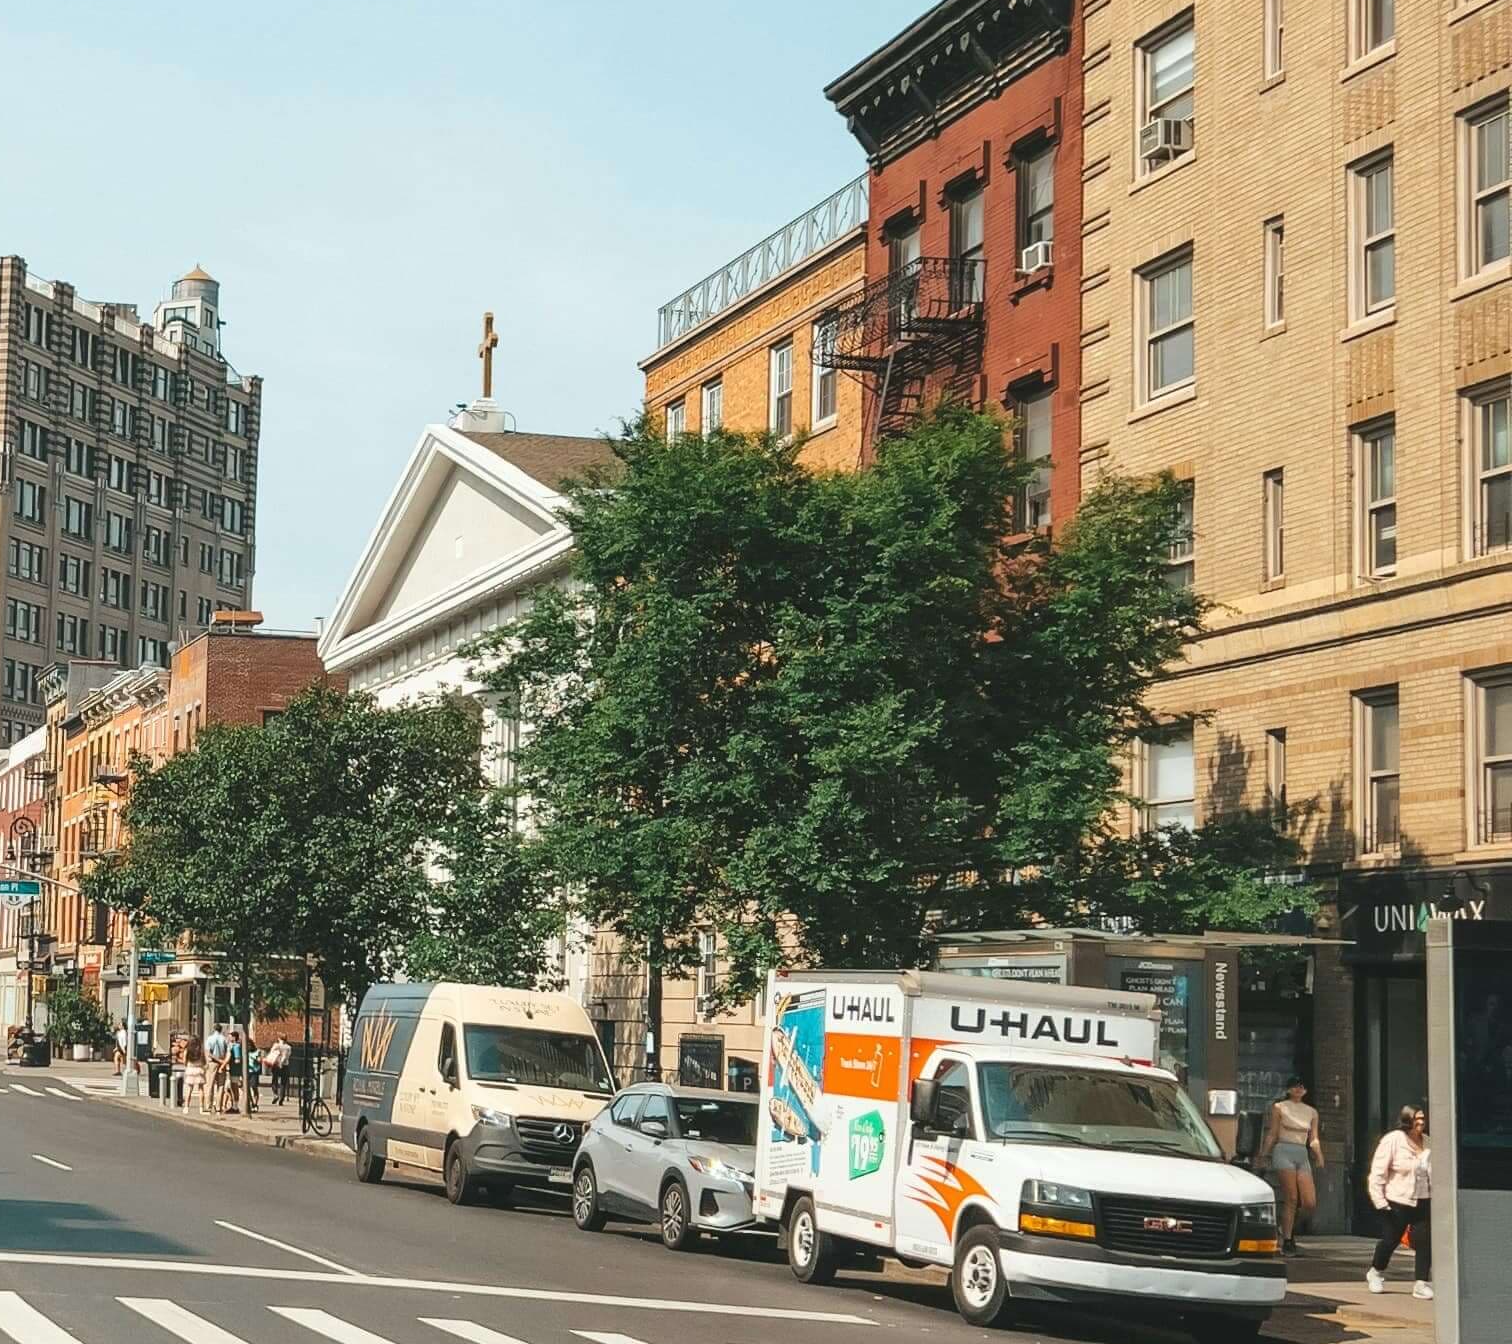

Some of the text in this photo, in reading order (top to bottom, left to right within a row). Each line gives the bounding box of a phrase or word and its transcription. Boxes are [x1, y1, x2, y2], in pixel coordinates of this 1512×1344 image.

[11, 882, 19, 891] Pl
[1149, 985, 1176, 993] AHEAD
[1162, 997, 1185, 1007] CAN
[1215, 960, 1228, 1040] Newsstand
[832, 995, 895, 1023] U-HAUL
[950, 1005, 1119, 1048] U-HAUL
[1143, 1216, 1193, 1233] GMC
